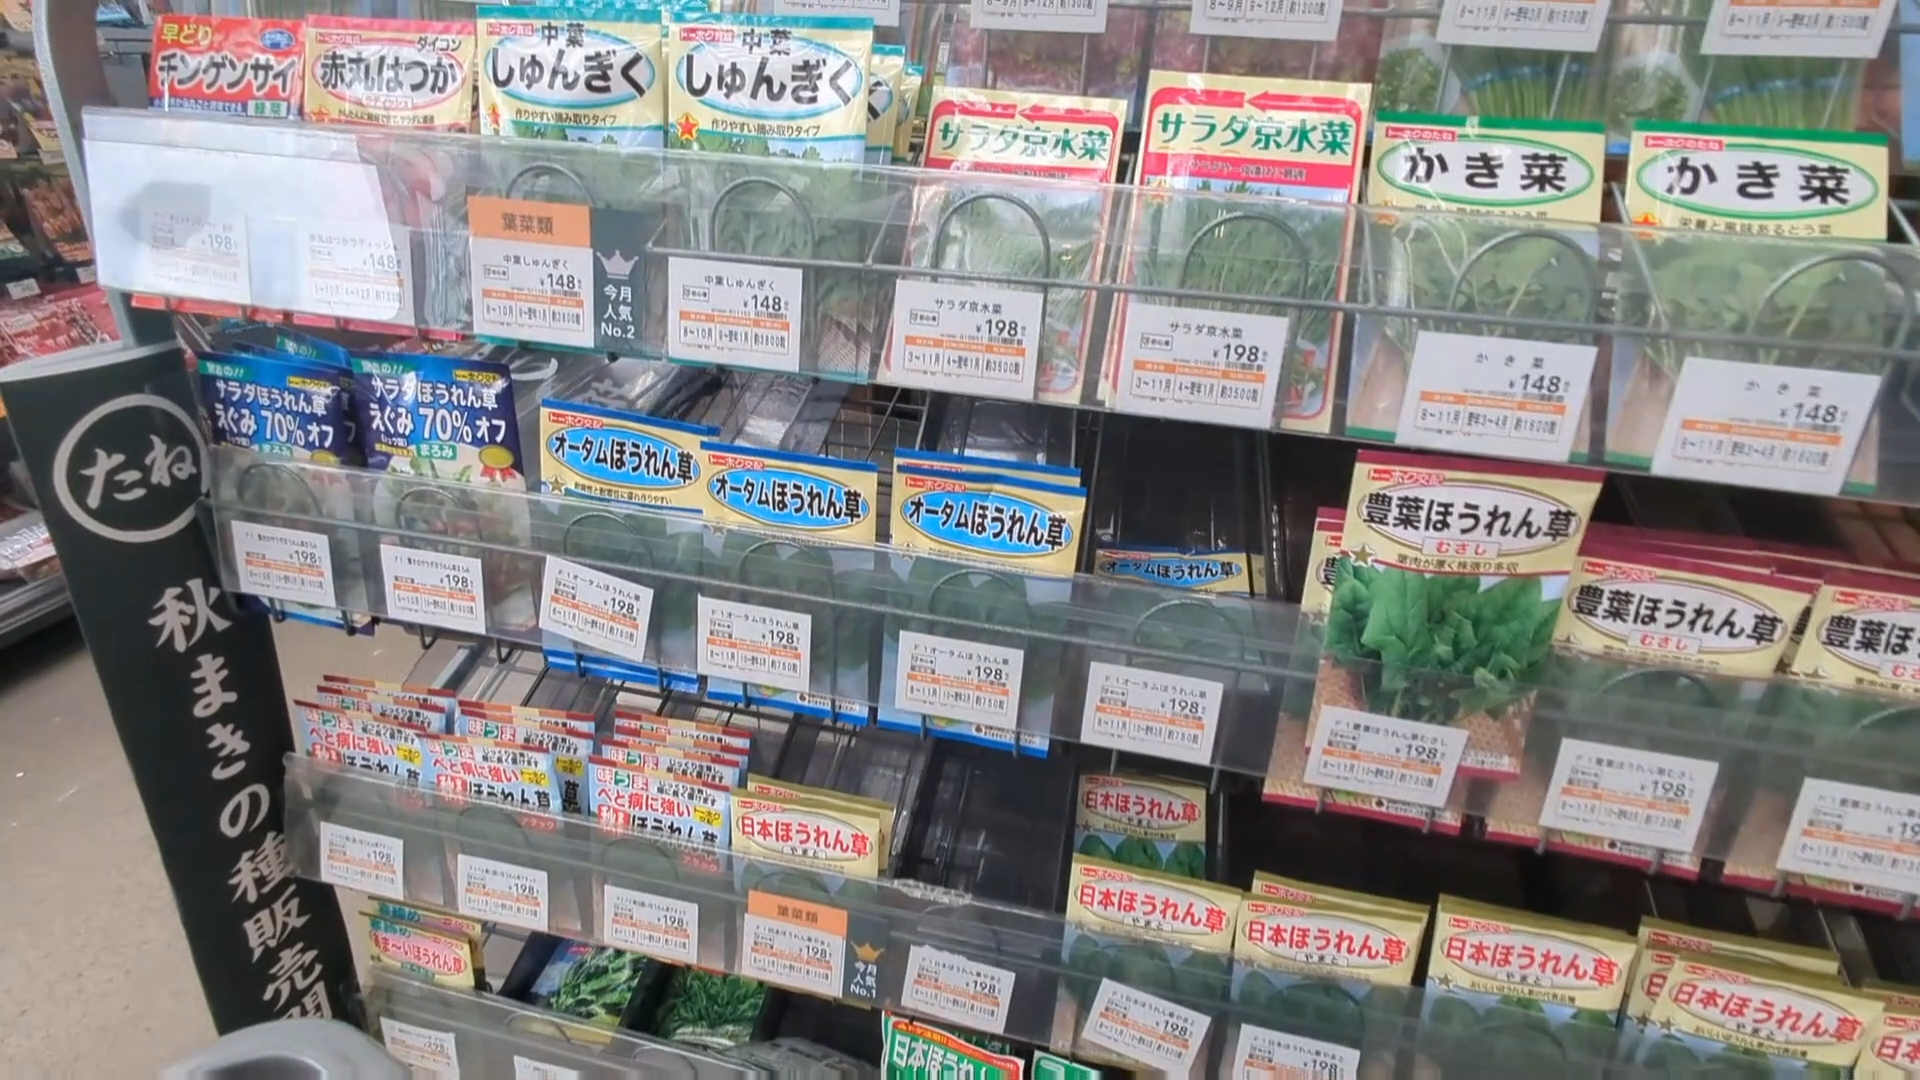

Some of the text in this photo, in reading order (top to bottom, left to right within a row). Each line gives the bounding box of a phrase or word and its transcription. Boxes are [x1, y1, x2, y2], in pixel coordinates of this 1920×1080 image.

[161, 23, 212, 46] 早どり
[416, 35, 462, 52] ダイコン
[540, 22, 585, 49] 中葉
[741, 28, 793, 56] 中葉
[158, 52, 298, 95] チンゲンサイ
[320, 51, 457, 95] 赤丸はつか
[491, 48, 646, 99] しゅんぎく
[685, 52, 853, 107] しゅんぎく
[938, 121, 1111, 162] サラダ京水菜
[1157, 111, 1353, 156] サラダ京水菜
[1401, 153, 1568, 195] かき菜
[1666, 157, 1851, 206] かき菜
[502, 212, 554, 237] 葉菜類
[539, 273, 576, 291] ¥148
[603, 284, 633, 303] 今月
[603, 302, 633, 322] 人気
[743, 294, 783, 312] ¥148
[601, 321, 636, 340] No.2
[975, 318, 1019, 338] ¥198
[1211, 343, 1260, 363] ¥198
[371, 376, 499, 411] サラダほうれん草
[1508, 373, 1562, 393] ¥148
[214, 379, 328, 417] サラダほうれん草
[1778, 402, 1840, 424] ¥148
[419, 444, 455, 459] まろみ
[554, 432, 694, 485] オータムほうれん草
[79, 433, 198, 511] たね
[715, 475, 862, 523] オータムほうれん草
[908, 497, 1068, 550] オータムほうれん草
[1362, 491, 1577, 543] 豊葉ほうれん草
[1435, 539, 1488, 557] むさし
[1106, 558, 1234, 579] オータムほうれん草
[602, 597, 635, 615] ¥198
[1572, 583, 1784, 647] 豊葉ほうれん草
[761, 629, 795, 646] ¥198
[1638, 633, 1688, 651] むさし
[966, 665, 1004, 682] ¥198
[1159, 697, 1201, 715] ¥198
[310, 727, 395, 756] べと病に強い
[468, 719, 516, 742] 味うま
[1394, 743, 1439, 760] ¥198
[433, 757, 520, 783] べと病に強い
[1640, 778, 1687, 798] ¥198
[598, 787, 691, 817] べと病に強い
[1085, 790, 1199, 824] 日本ほうれん草
[741, 815, 870, 857] 日本ほうれん草
[1078, 882, 1228, 935] 日本ほうれん草
[1247, 919, 1407, 966] 日本ほうれん草
[854, 959, 878, 976] 今月
[1445, 936, 1619, 988] 日本ほうれん草
[850, 983, 877, 999] No.1
[1673, 981, 1865, 1044] 日本ほうれん草
[1155, 1017, 1189, 1037] ¥198
